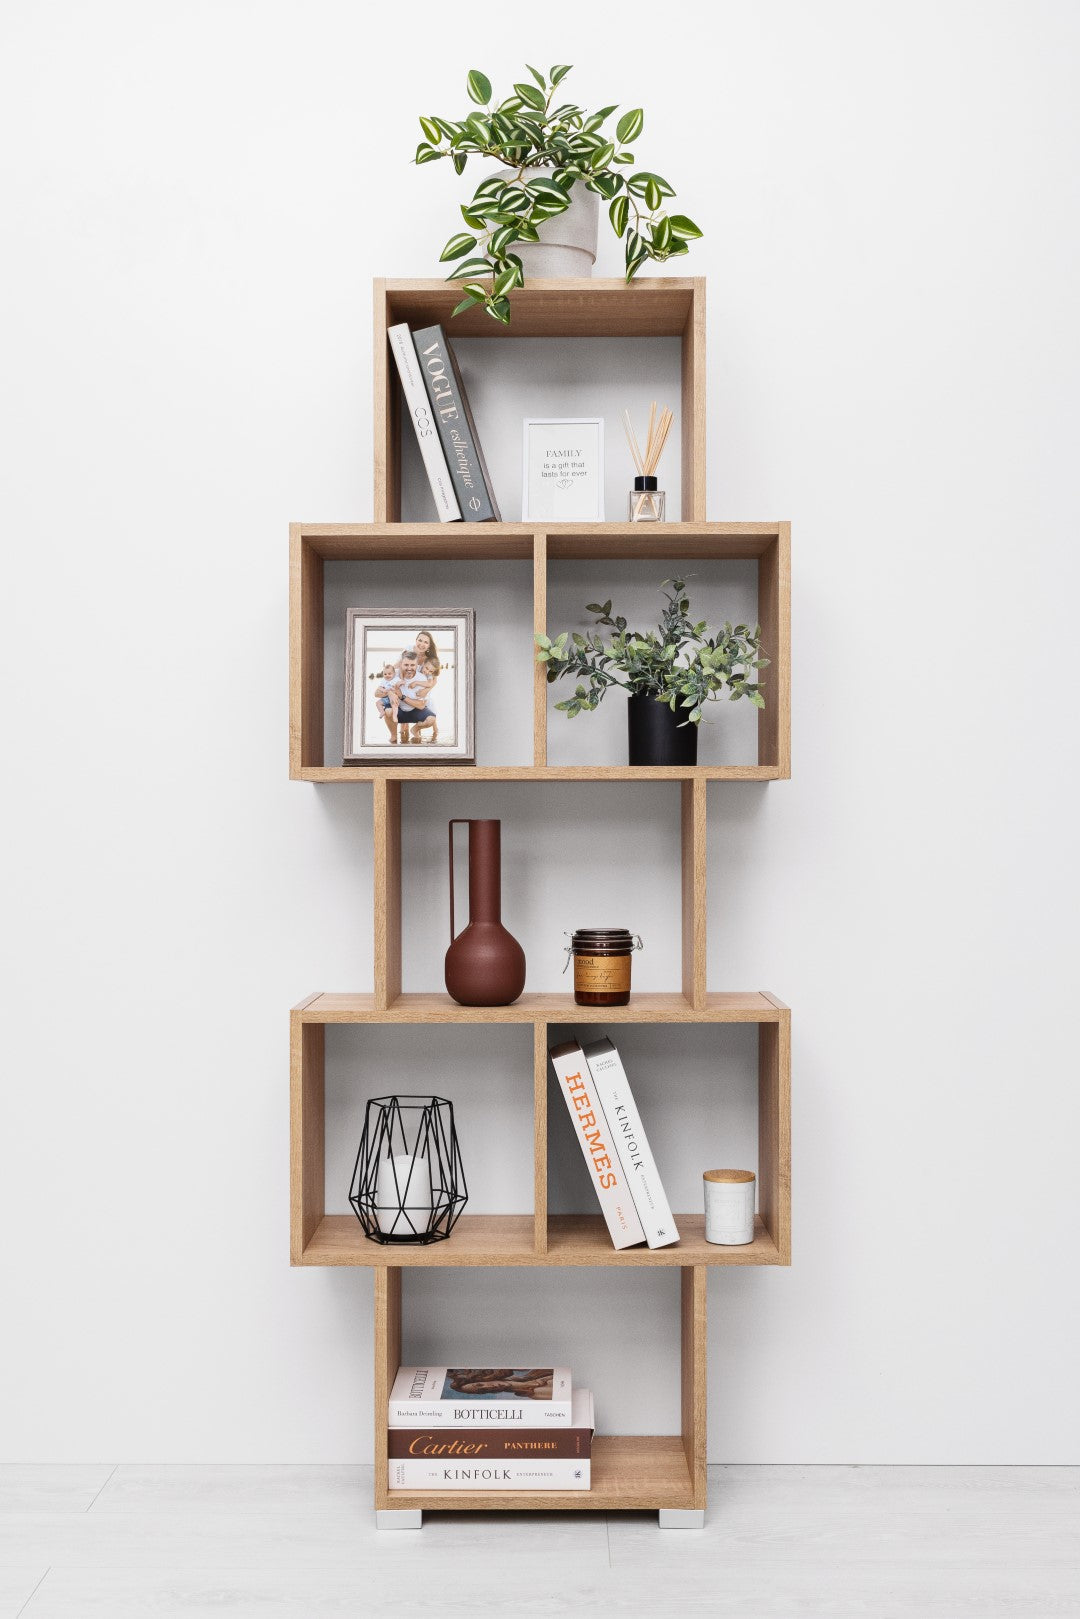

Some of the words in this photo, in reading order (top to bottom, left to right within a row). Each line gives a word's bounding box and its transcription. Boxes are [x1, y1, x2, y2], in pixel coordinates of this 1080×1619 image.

[423, 343, 458, 423] VOGUE
[415, 407, 432, 438] COS
[545, 449, 583, 457] FAMILY
[558, 462, 569, 470] gift
[615, 1105, 644, 1171] KINFOLK
[616, 1206, 628, 1231] PARIS
[454, 1409, 523, 1420] BOTTICELLI
[409, 1435, 488, 1455] Cartier
[504, 1442, 558, 1450] PANTHERE
[443, 1469, 512, 1480] KINFOLK
